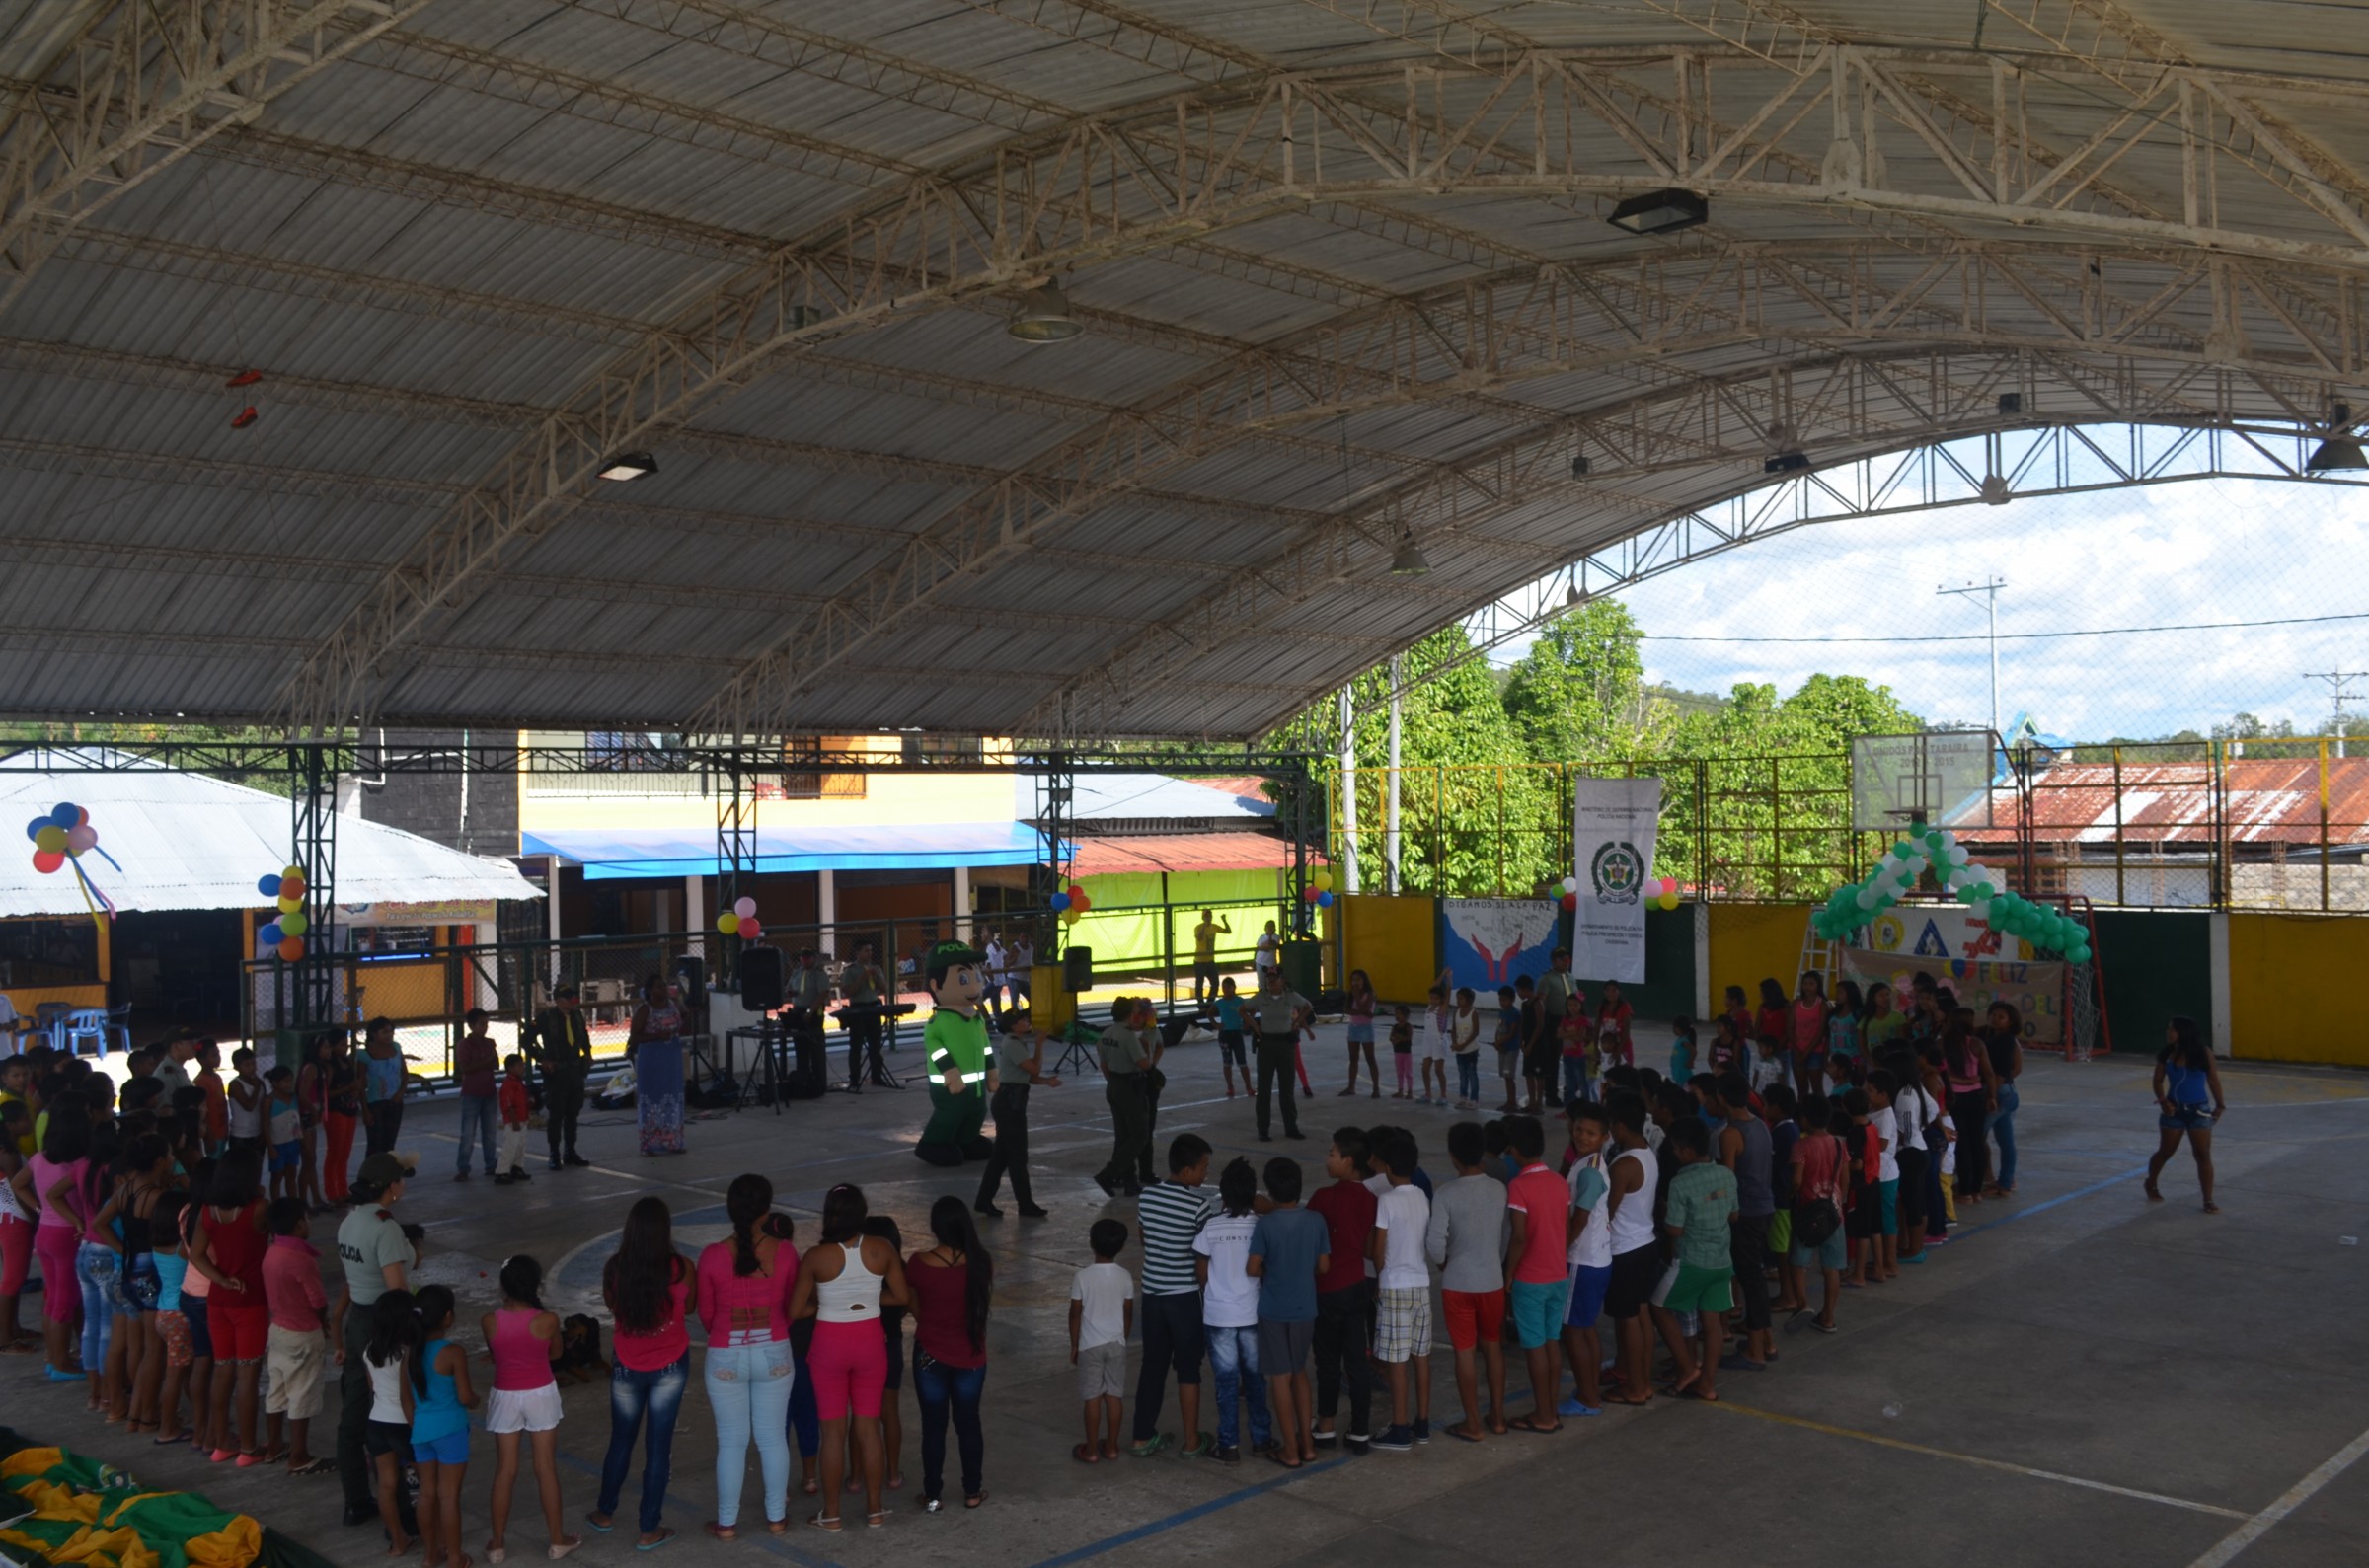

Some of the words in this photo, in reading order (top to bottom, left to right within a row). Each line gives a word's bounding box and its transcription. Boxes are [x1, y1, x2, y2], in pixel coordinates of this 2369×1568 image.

[1532, 902, 1551, 911] PAZ
[1979, 962, 2028, 984] FELIZ
[2021, 993, 2057, 1015] DEL
[338, 1242, 364, 1264] OLICIA
